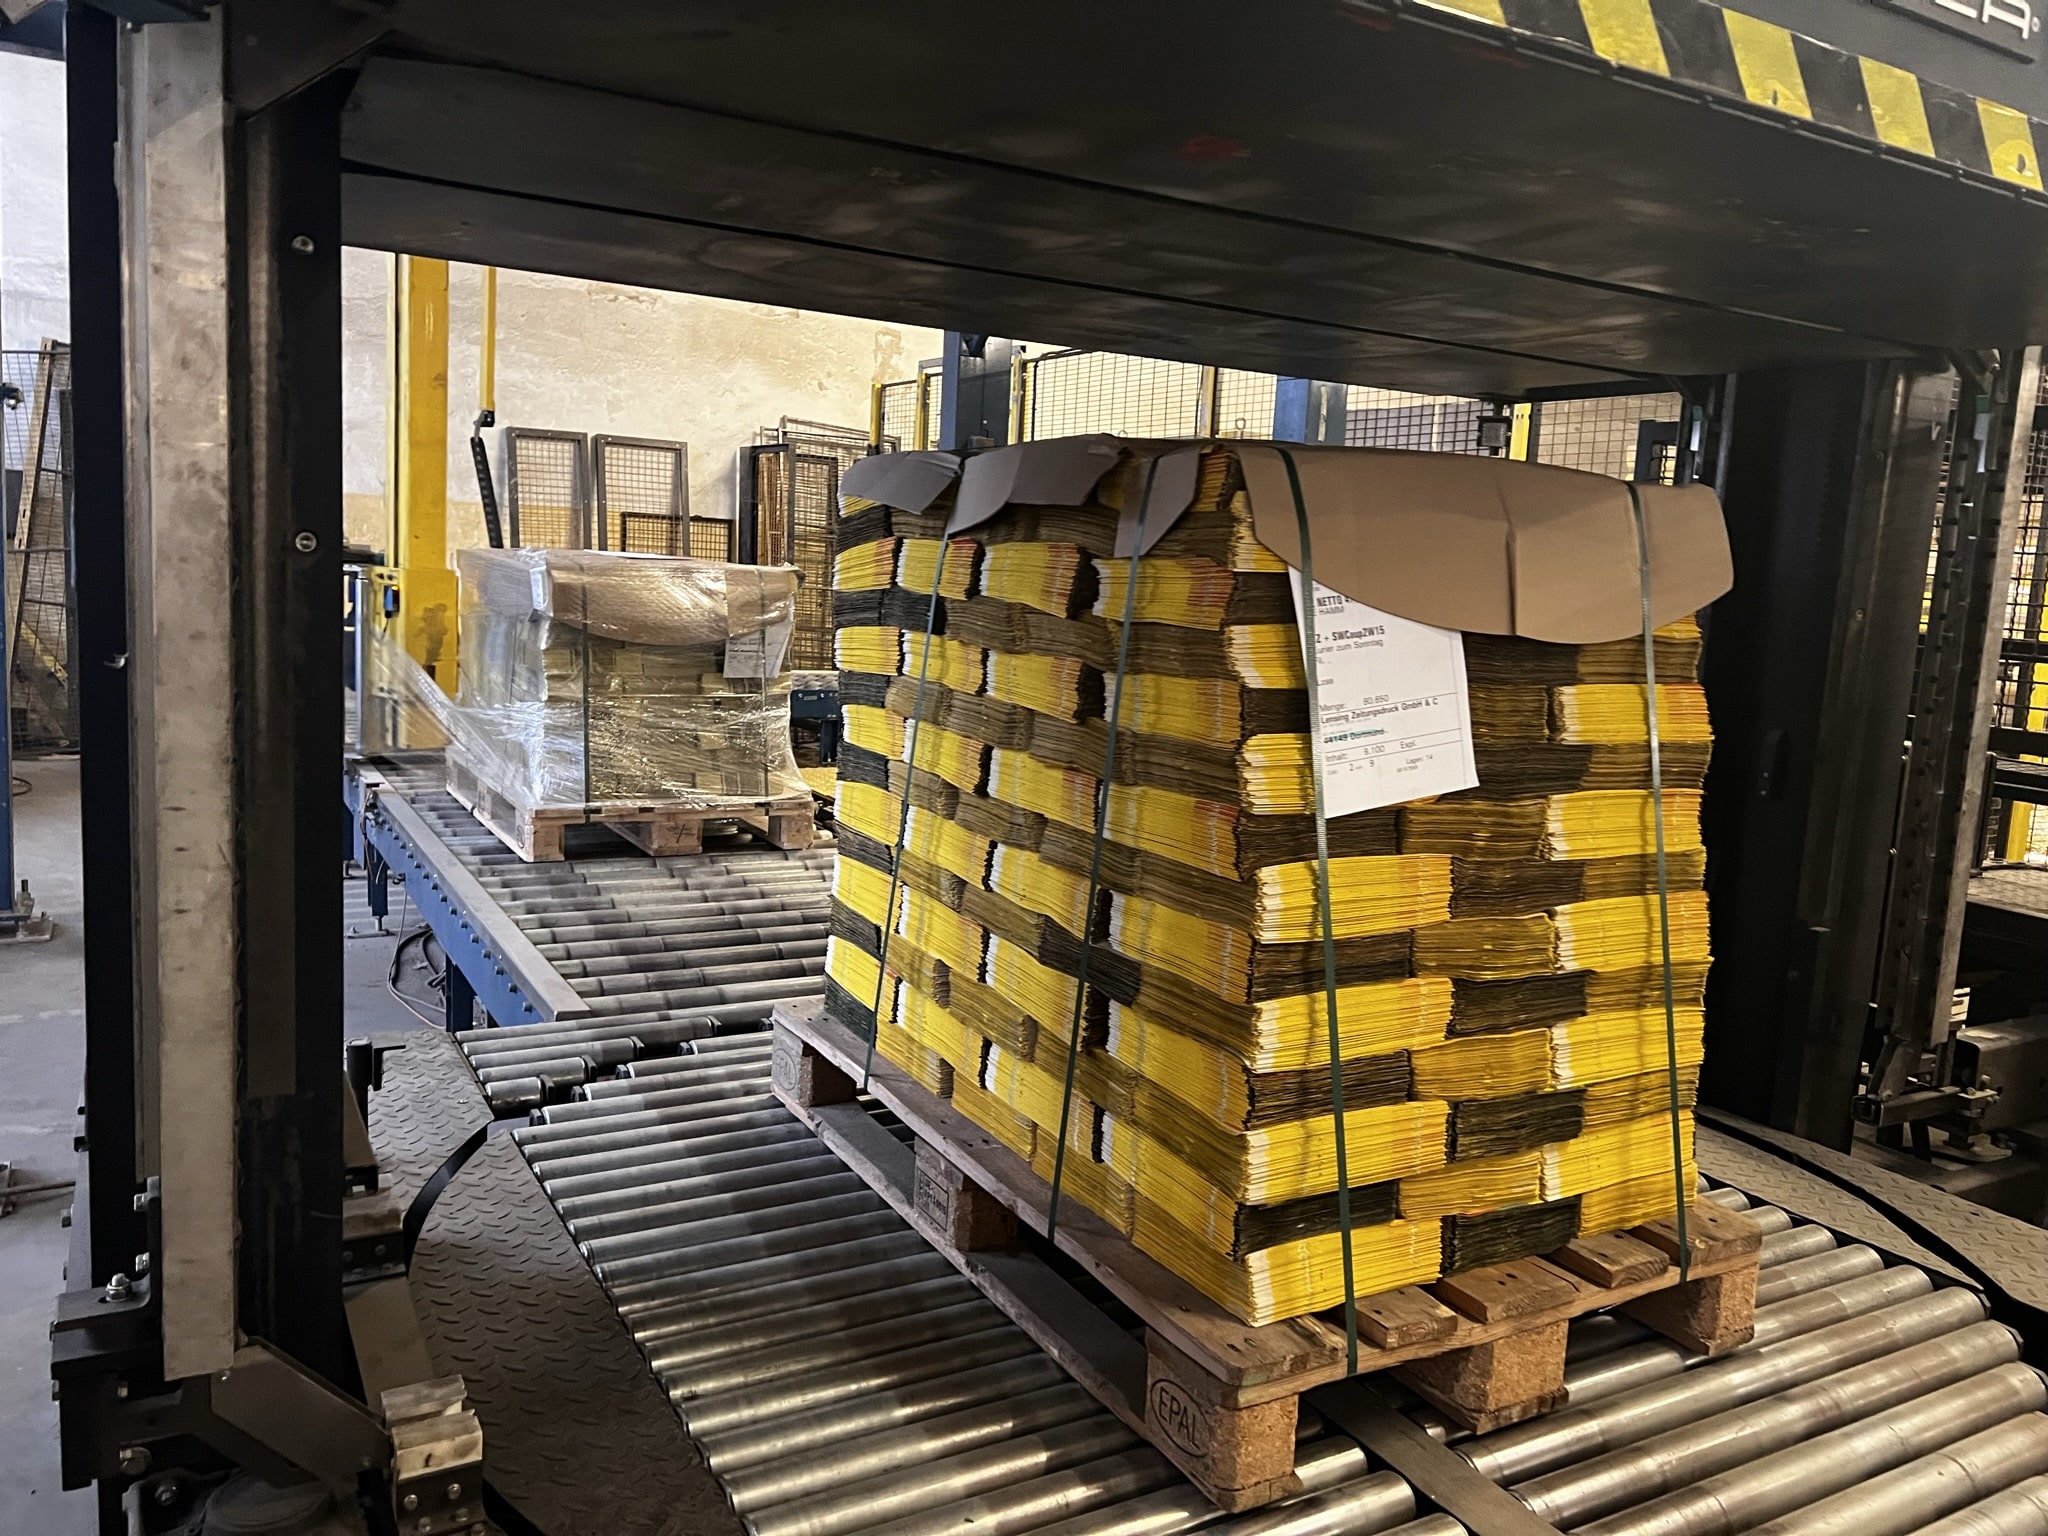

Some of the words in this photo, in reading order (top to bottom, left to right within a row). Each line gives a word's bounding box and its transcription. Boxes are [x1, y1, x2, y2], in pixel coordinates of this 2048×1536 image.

[1317, 595, 1343, 607] NETTO
[1321, 714, 1349, 724] Lensing
[1352, 705, 1399, 719] Zeitungsdruck
[1401, 701, 1422, 710] GmbH
[1160, 1386, 1200, 1450] EPAL
